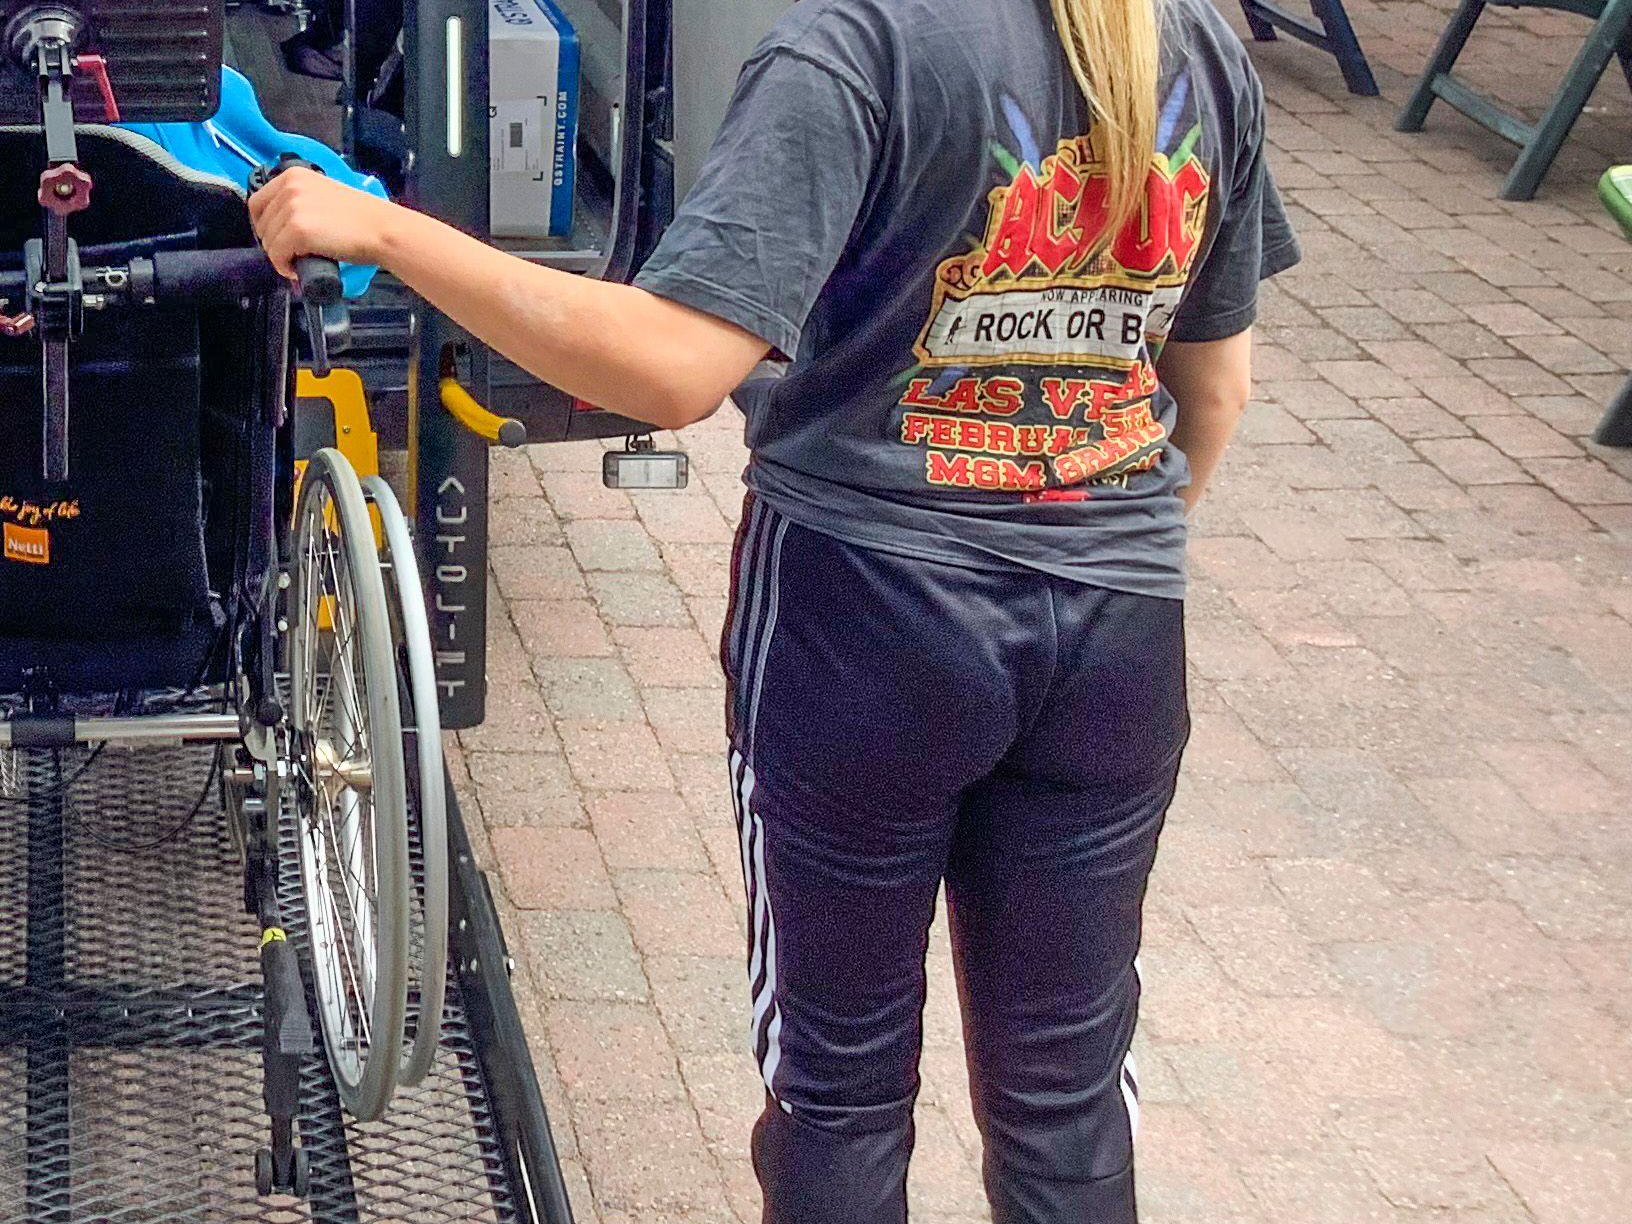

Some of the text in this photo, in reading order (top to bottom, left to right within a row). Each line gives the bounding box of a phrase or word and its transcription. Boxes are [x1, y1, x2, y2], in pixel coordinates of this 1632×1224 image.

[974, 309, 1055, 342] ROCK
[1066, 308, 1106, 341] OR
[899, 376, 1024, 416] LAS
[925, 450, 1047, 490] MGM
